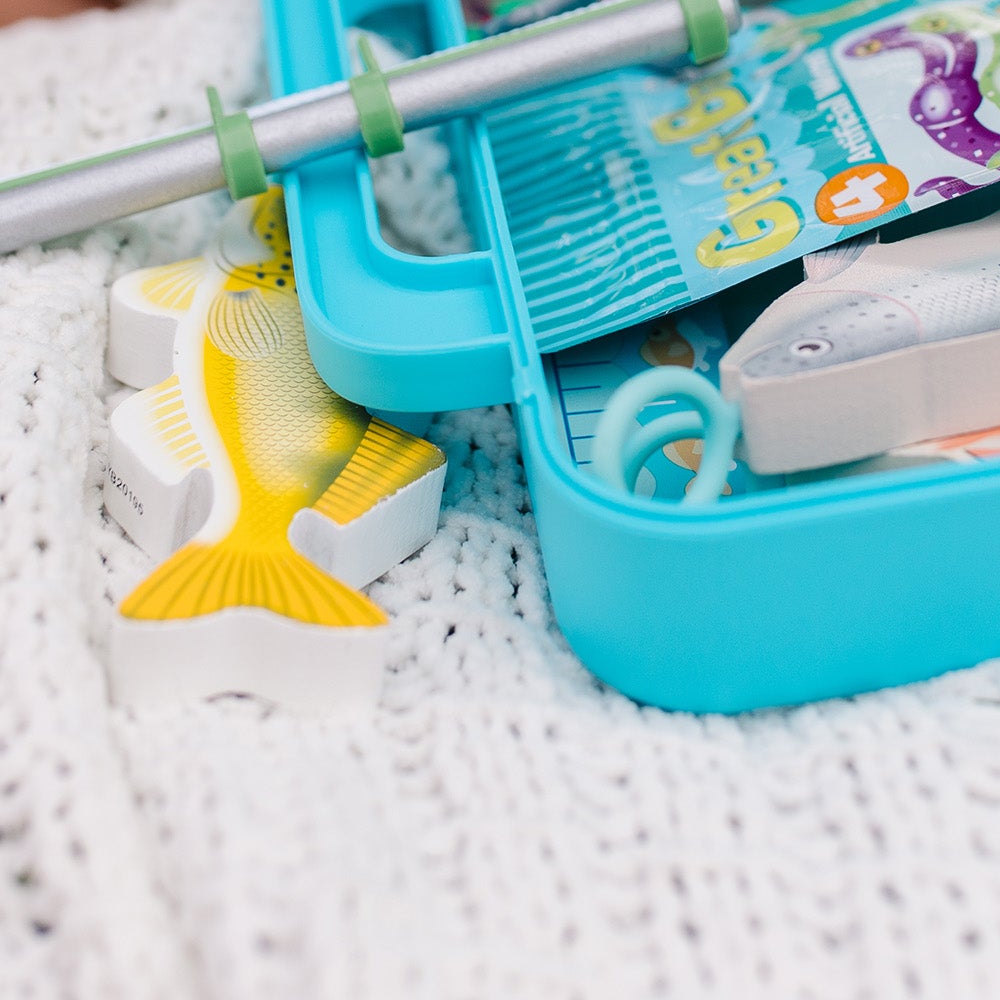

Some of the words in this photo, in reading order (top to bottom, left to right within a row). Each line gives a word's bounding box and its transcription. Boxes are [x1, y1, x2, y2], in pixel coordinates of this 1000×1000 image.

[816, 92, 878, 164] Artificial
[691, 116, 803, 269] Great
[829, 171, 888, 219] 4
